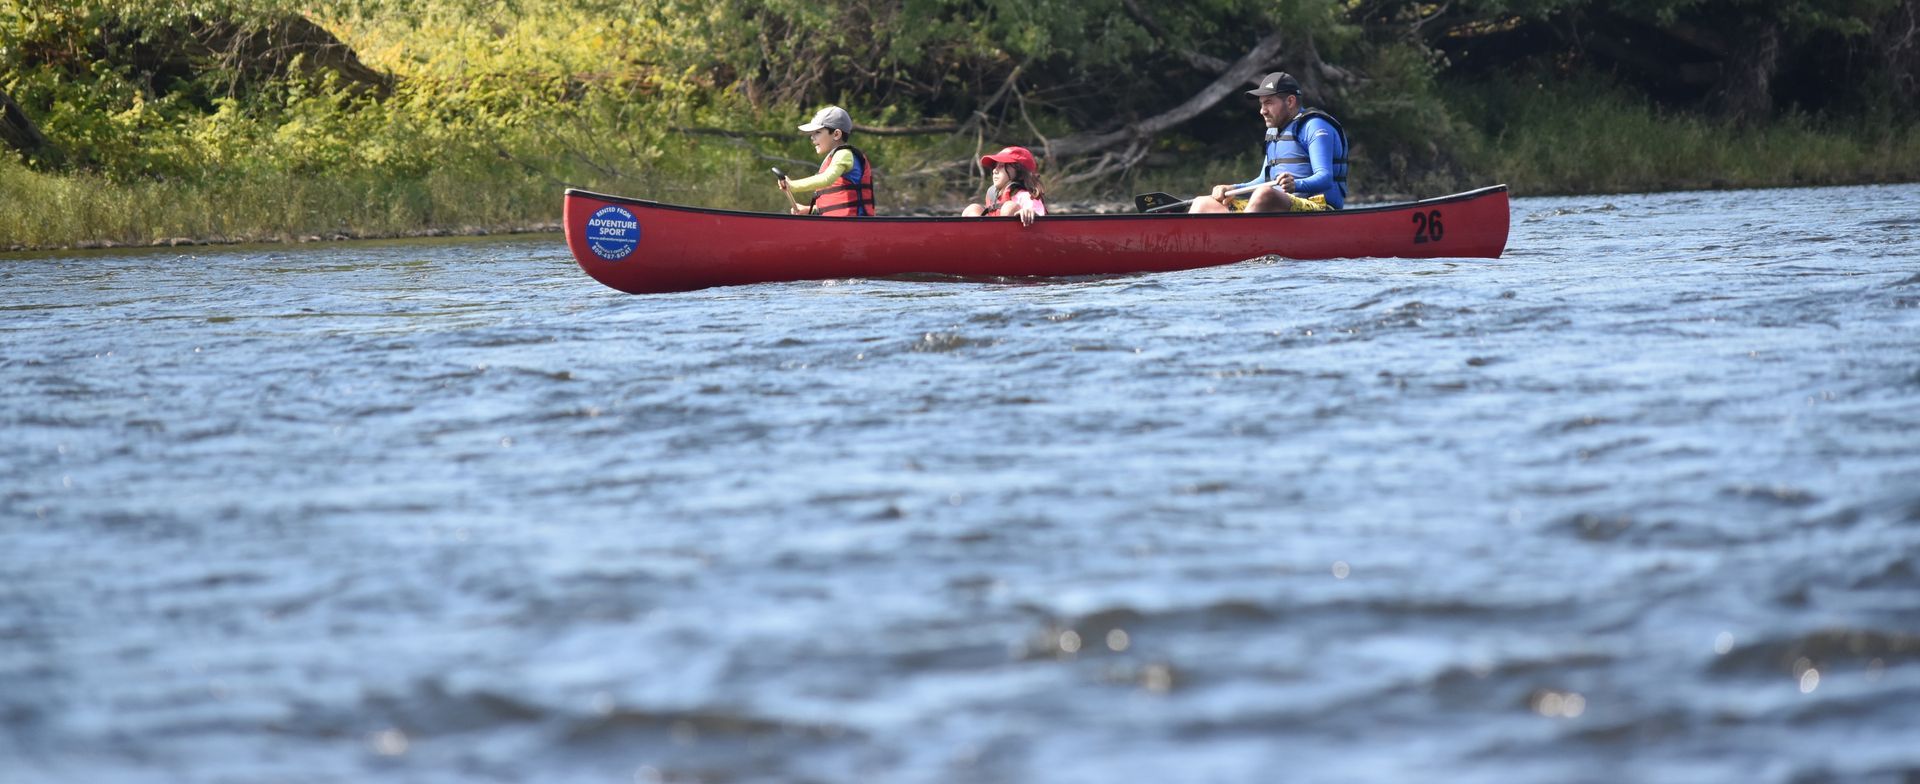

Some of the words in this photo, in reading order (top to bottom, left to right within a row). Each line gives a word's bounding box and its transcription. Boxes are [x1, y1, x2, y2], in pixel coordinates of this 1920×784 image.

[596, 206, 616, 218] RENTED
[616, 207, 632, 219] FROM
[588, 218, 637, 229] ADVENTURE
[1412, 209, 1444, 244] 26
[599, 227, 626, 236] SPORT
